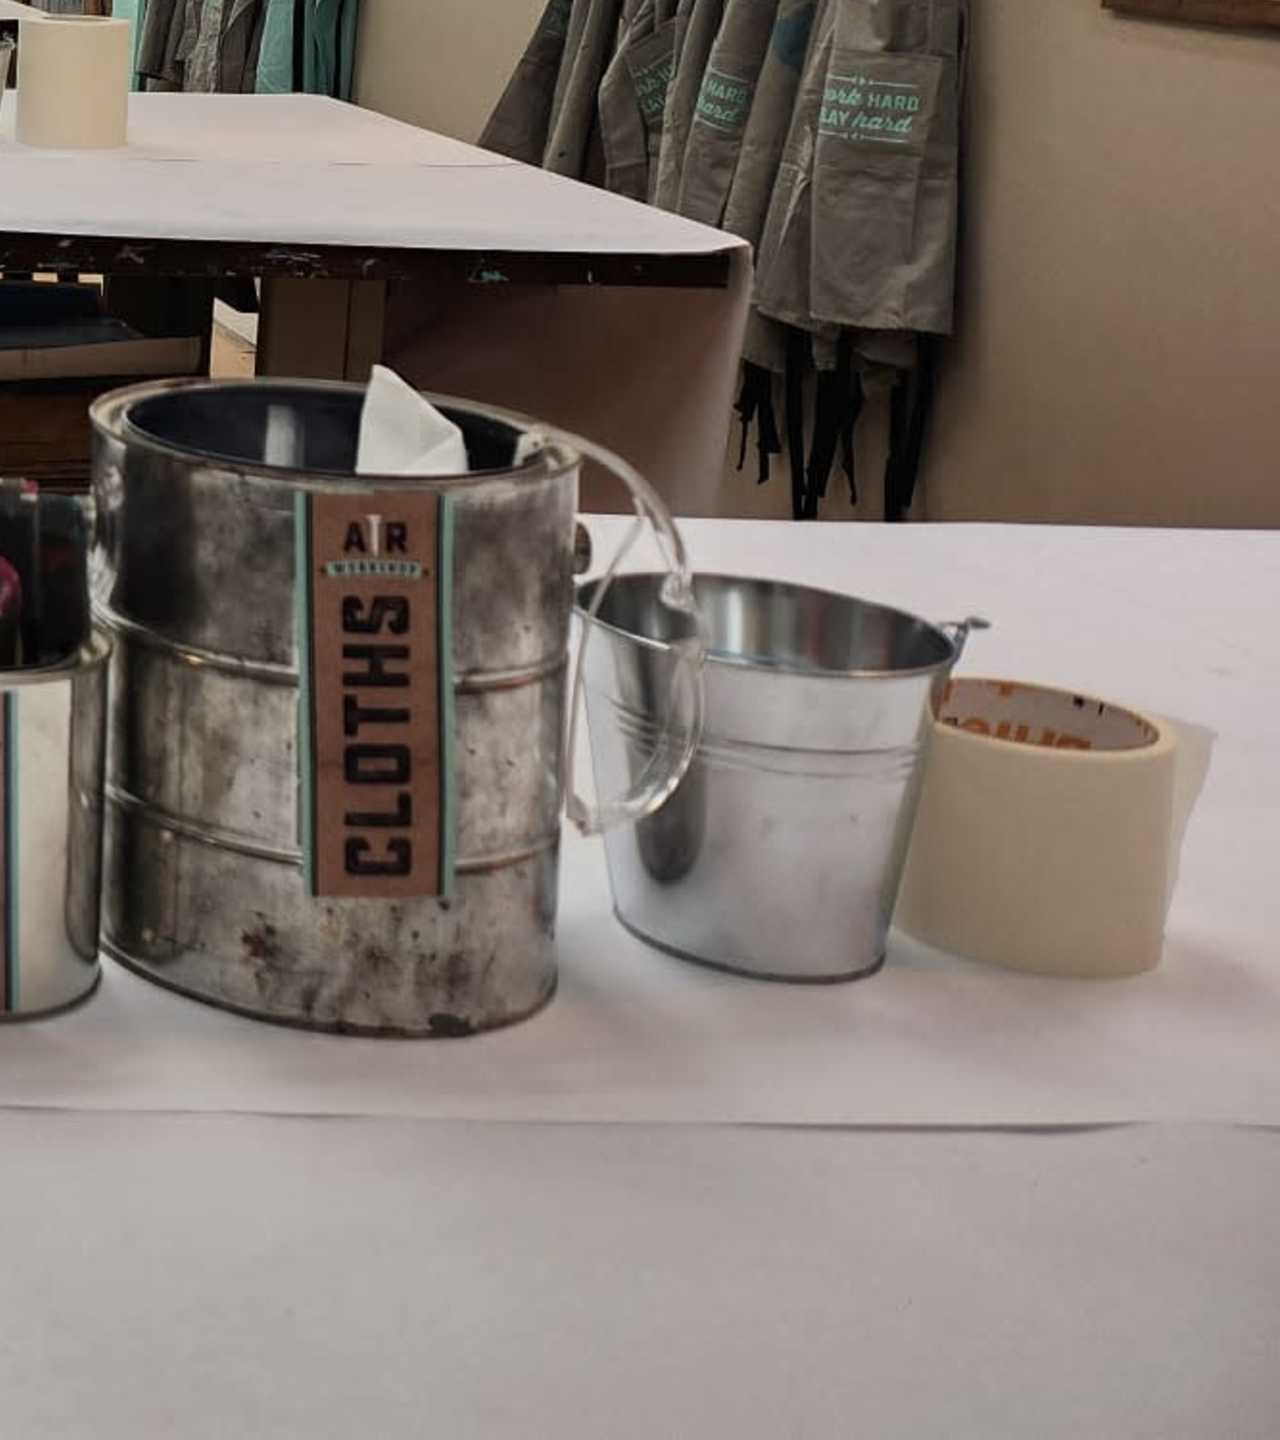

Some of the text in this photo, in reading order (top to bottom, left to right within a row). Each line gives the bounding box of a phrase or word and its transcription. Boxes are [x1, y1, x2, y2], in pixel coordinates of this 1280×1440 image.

[824, 86, 920, 110] ork HARD
[851, 109, 913, 133] hard
[341, 593, 413, 878] CLOTHS
